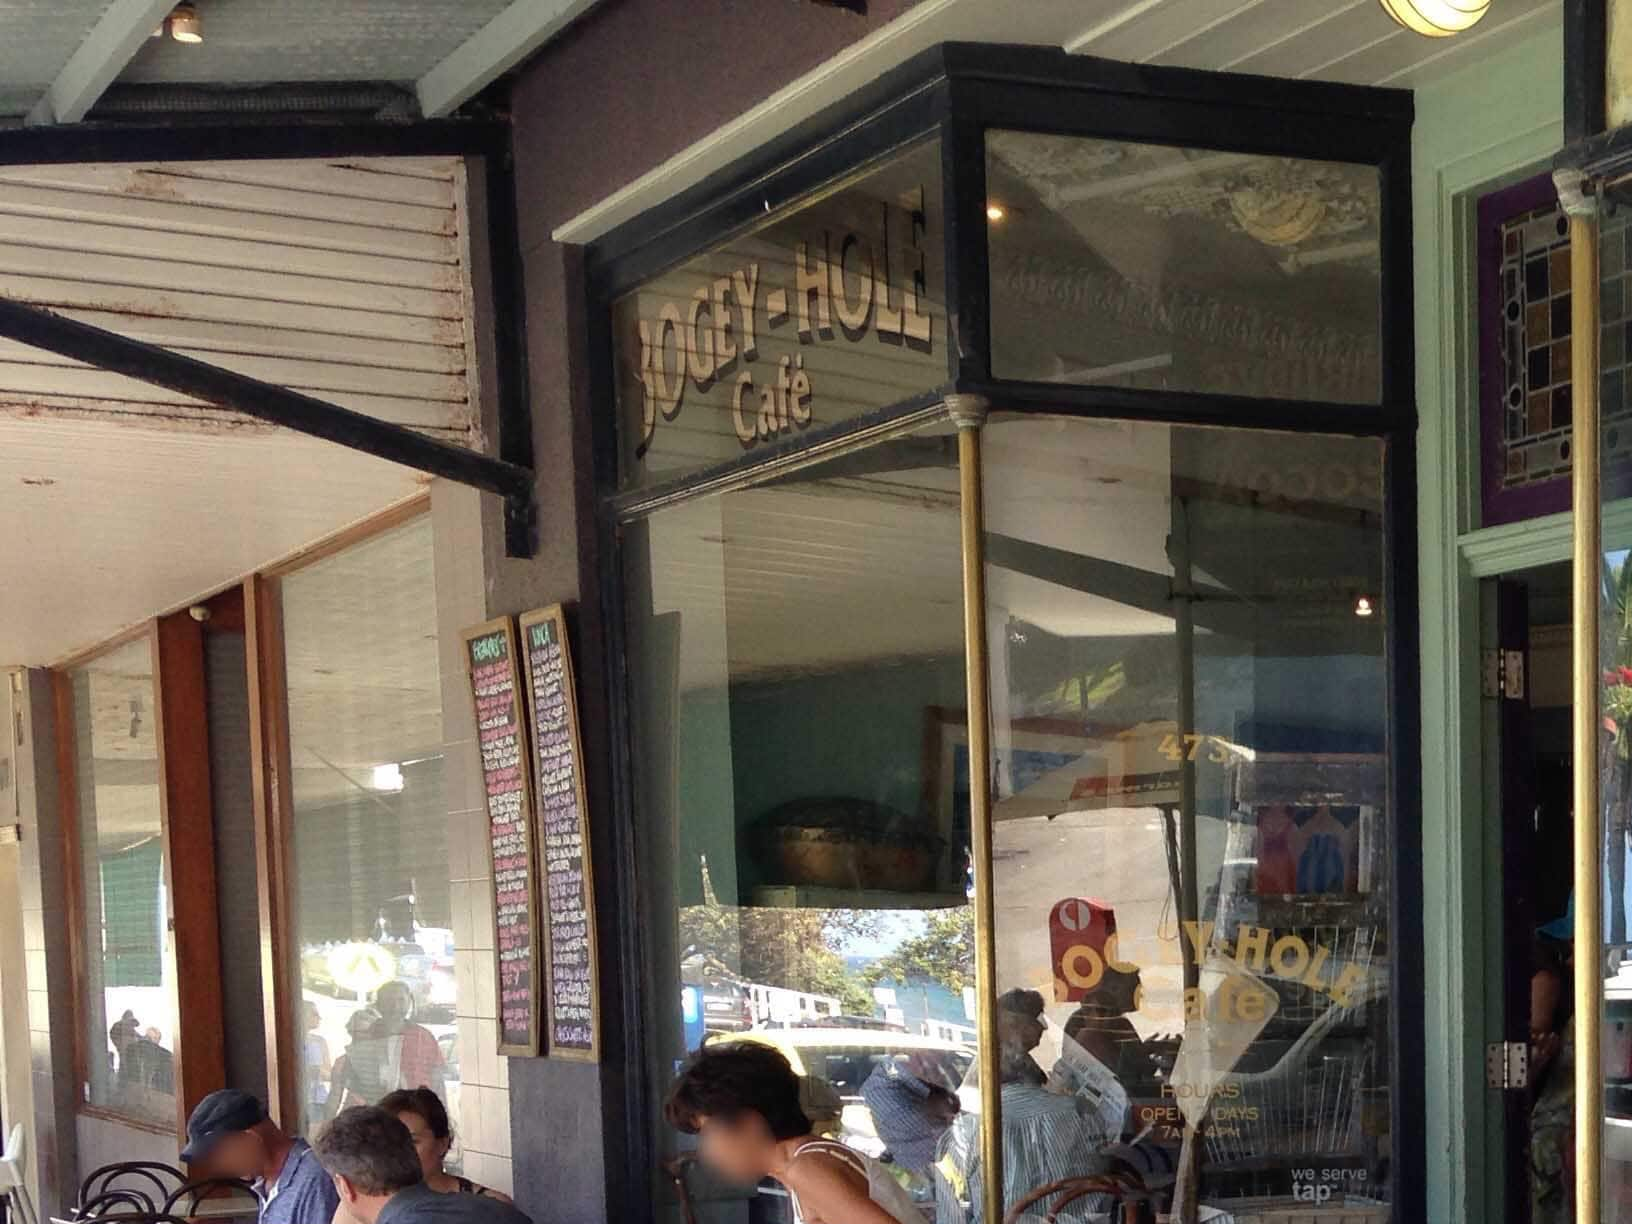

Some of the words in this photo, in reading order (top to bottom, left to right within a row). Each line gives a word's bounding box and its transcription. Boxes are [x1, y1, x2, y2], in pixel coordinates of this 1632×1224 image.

[1161, 1081, 1241, 1099] HOURS
[1215, 1106, 1260, 1121] DAYS
[1290, 1167, 1316, 1181] we
[1320, 1167, 1368, 1181] serve
